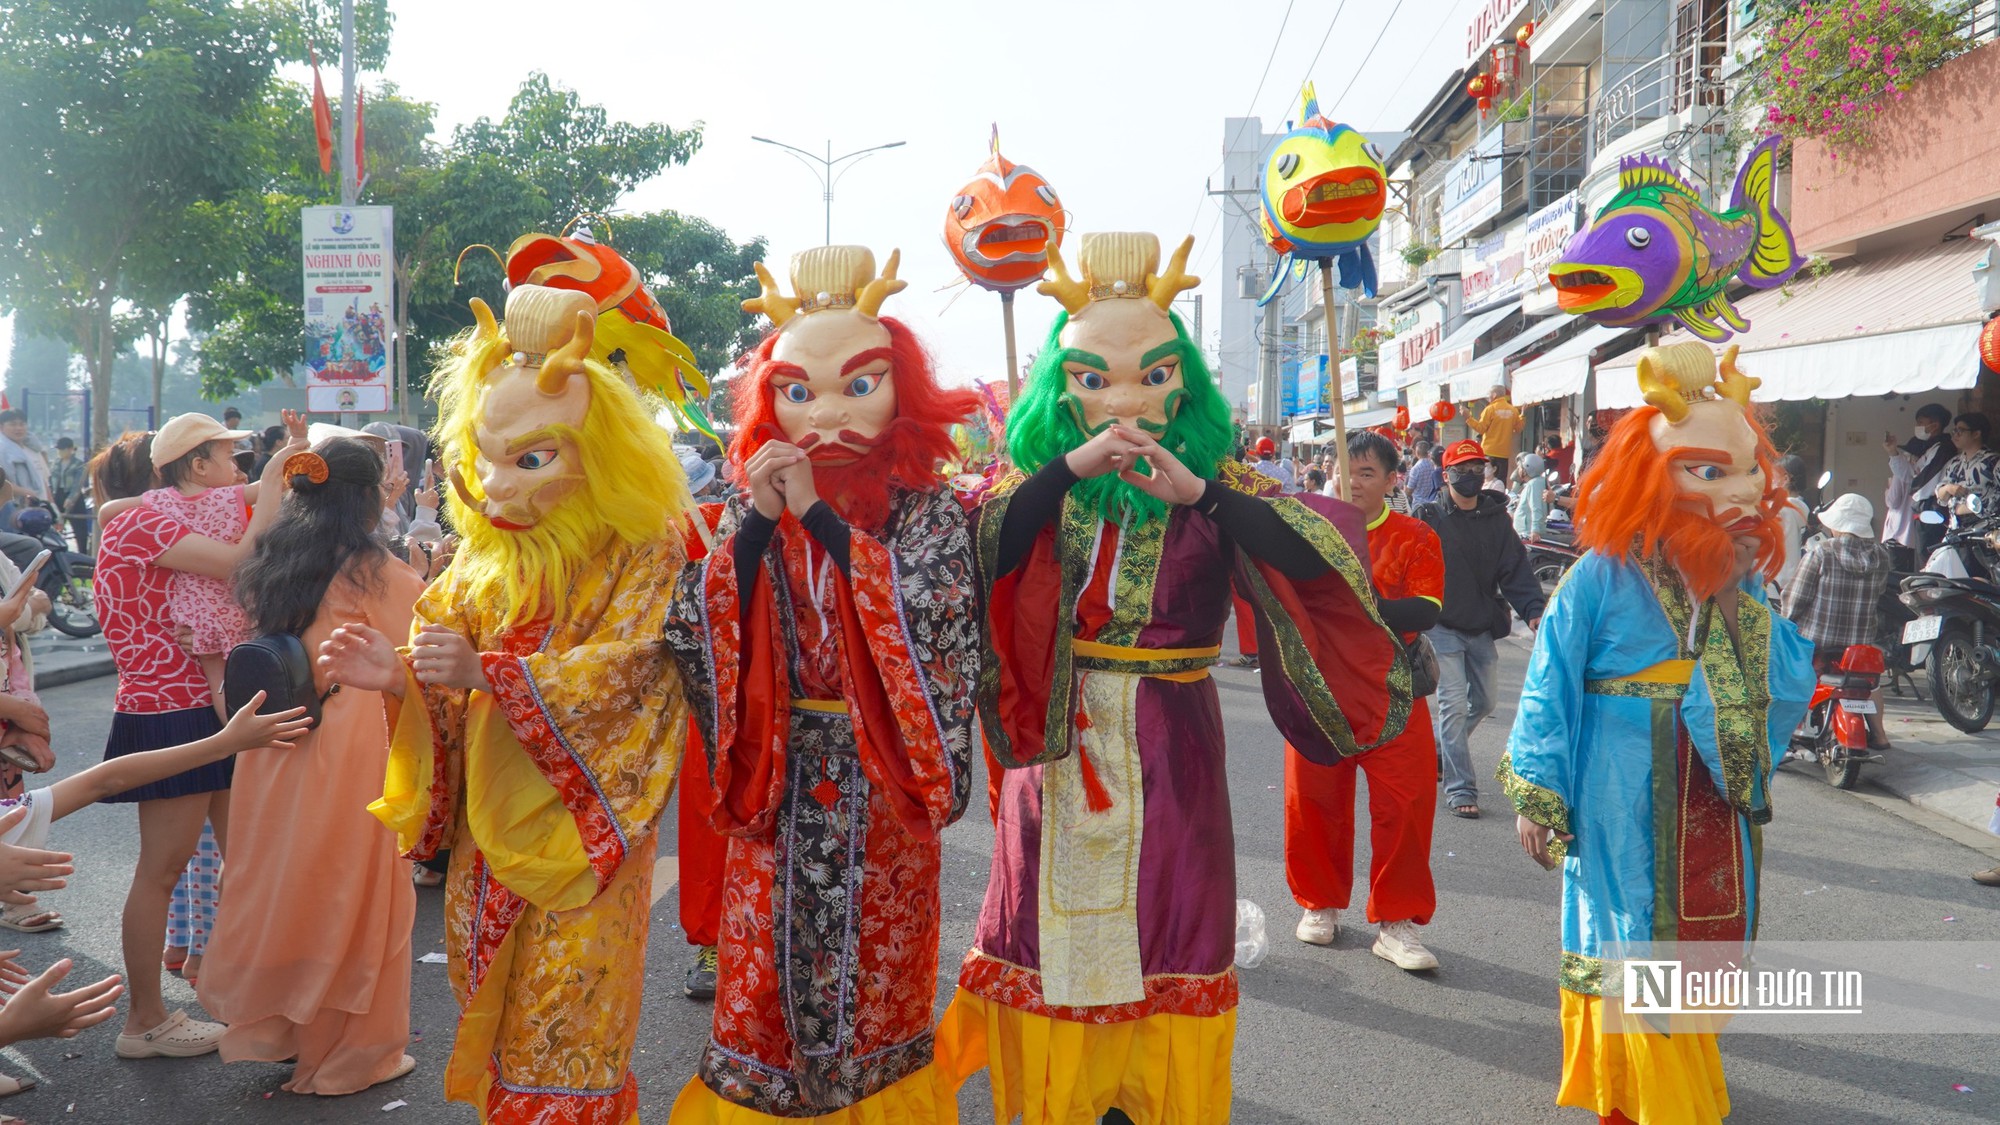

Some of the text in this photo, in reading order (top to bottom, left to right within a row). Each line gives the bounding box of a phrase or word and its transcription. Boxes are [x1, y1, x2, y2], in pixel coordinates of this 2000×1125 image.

[1467, 0, 1520, 59] HITAC
[306, 251, 381, 269] NGHINH ÔNG
